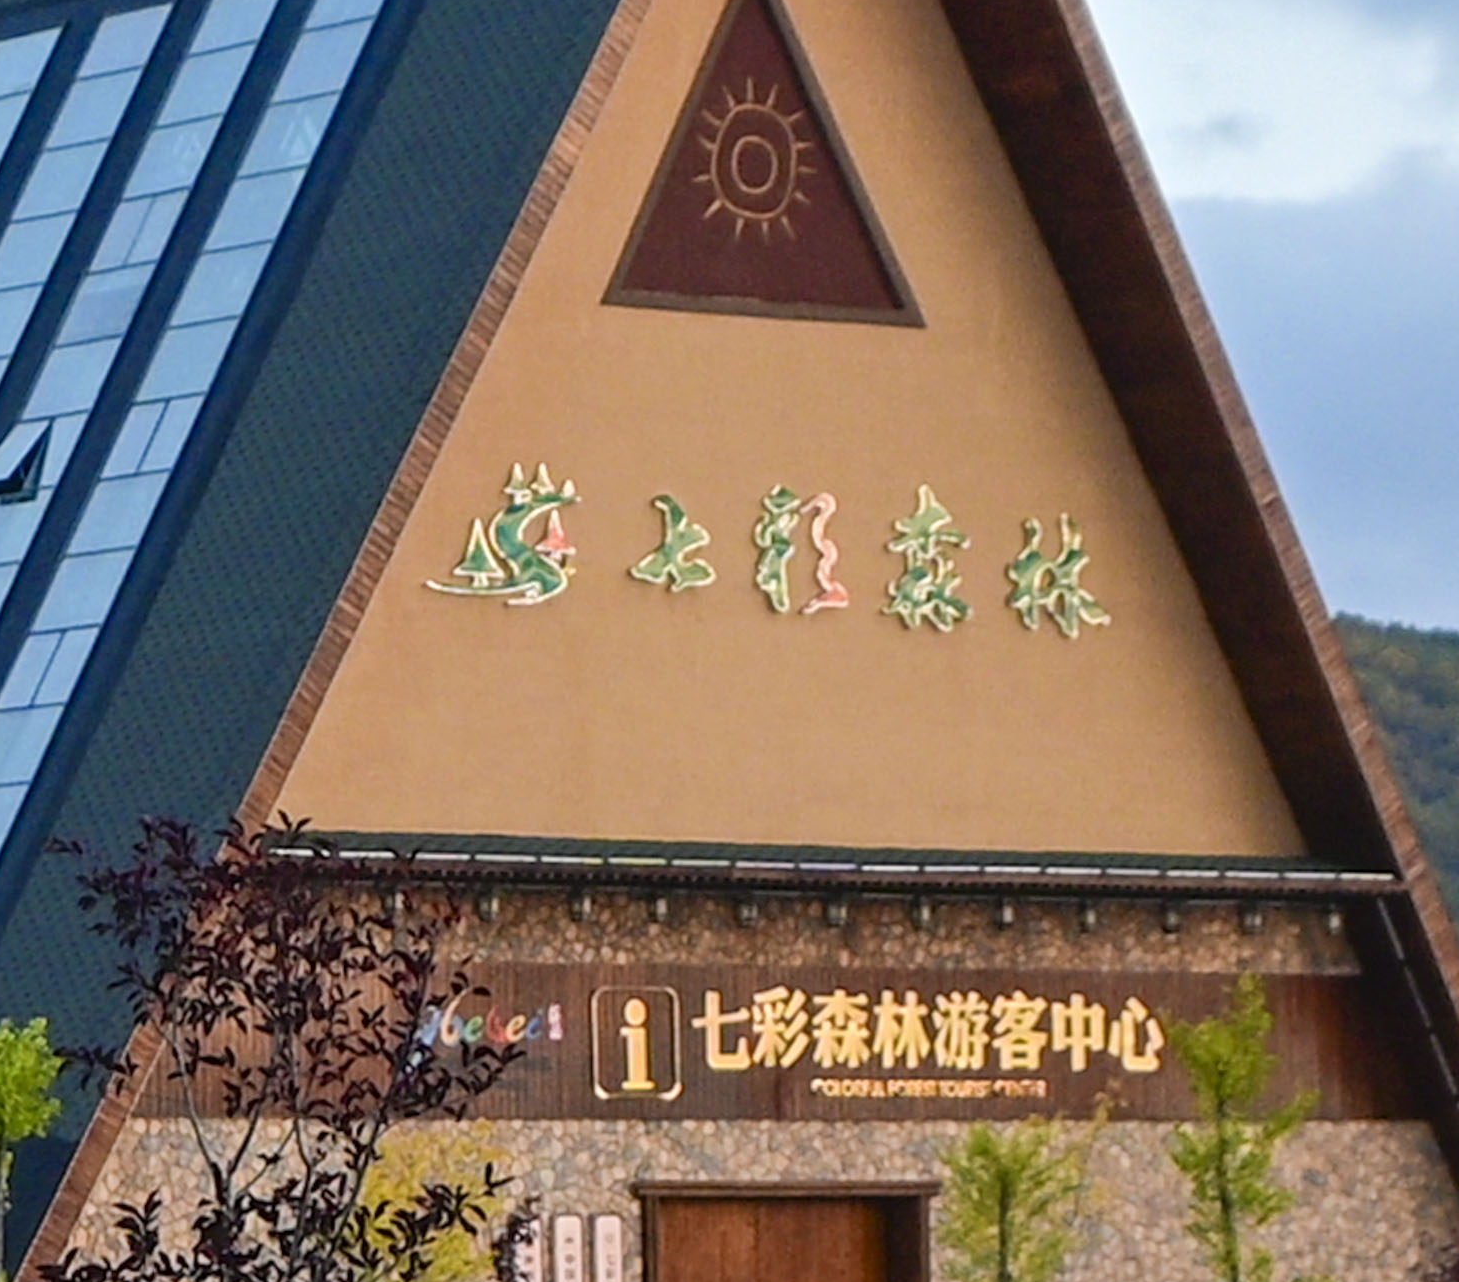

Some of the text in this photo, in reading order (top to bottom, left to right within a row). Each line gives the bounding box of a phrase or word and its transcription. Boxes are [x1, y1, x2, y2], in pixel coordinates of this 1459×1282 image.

[629, 484, 1111, 639] 七彩森林
[691, 985, 1166, 1073] 七彩森林游客中心
